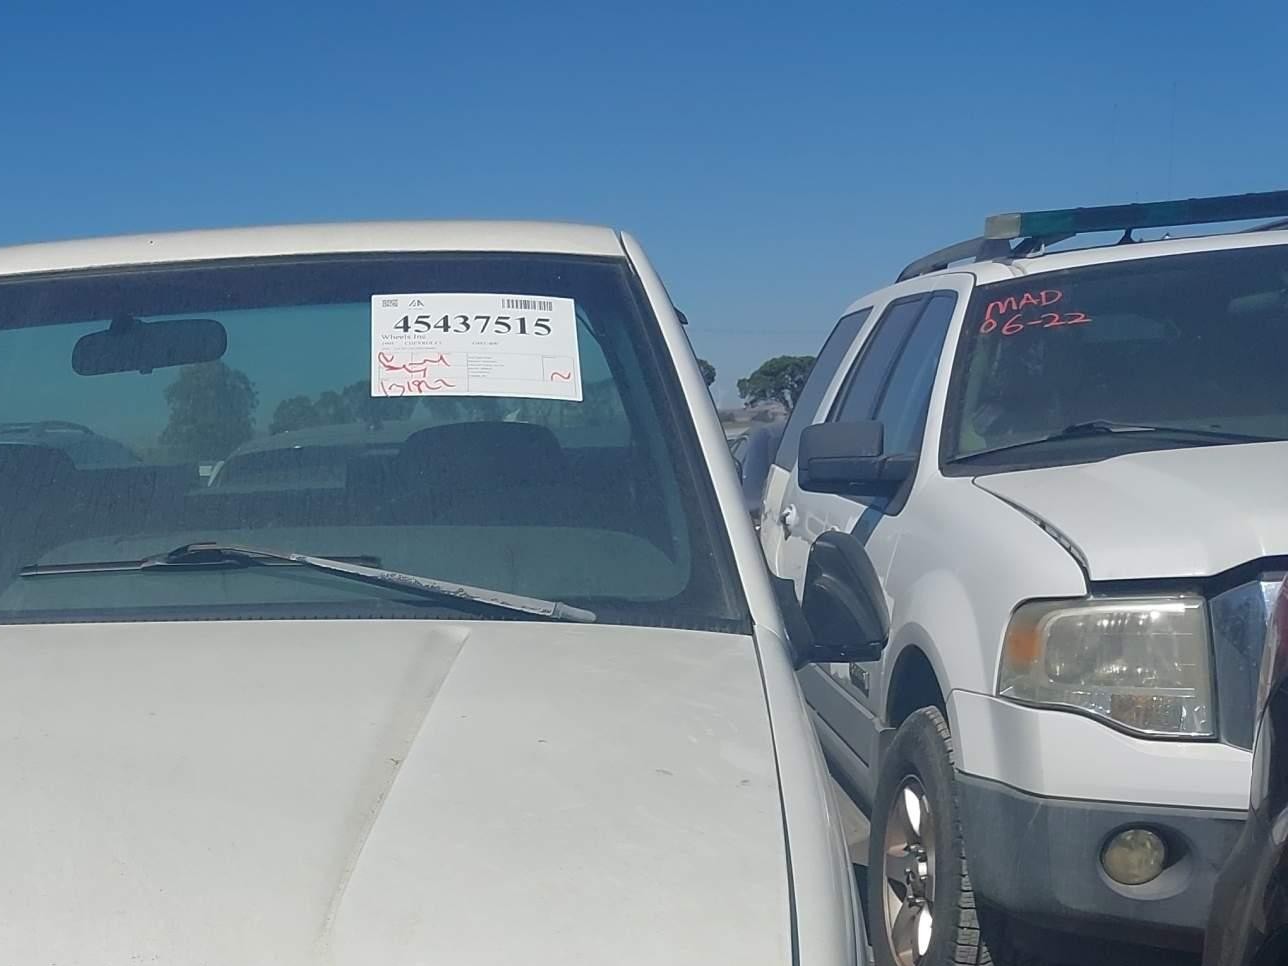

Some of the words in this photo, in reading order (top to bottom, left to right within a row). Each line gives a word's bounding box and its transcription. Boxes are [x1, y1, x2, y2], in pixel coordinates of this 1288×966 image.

[985, 289, 1063, 320] MAD
[393, 315, 552, 336] 45437515
[979, 312, 1092, 336] 06-22
